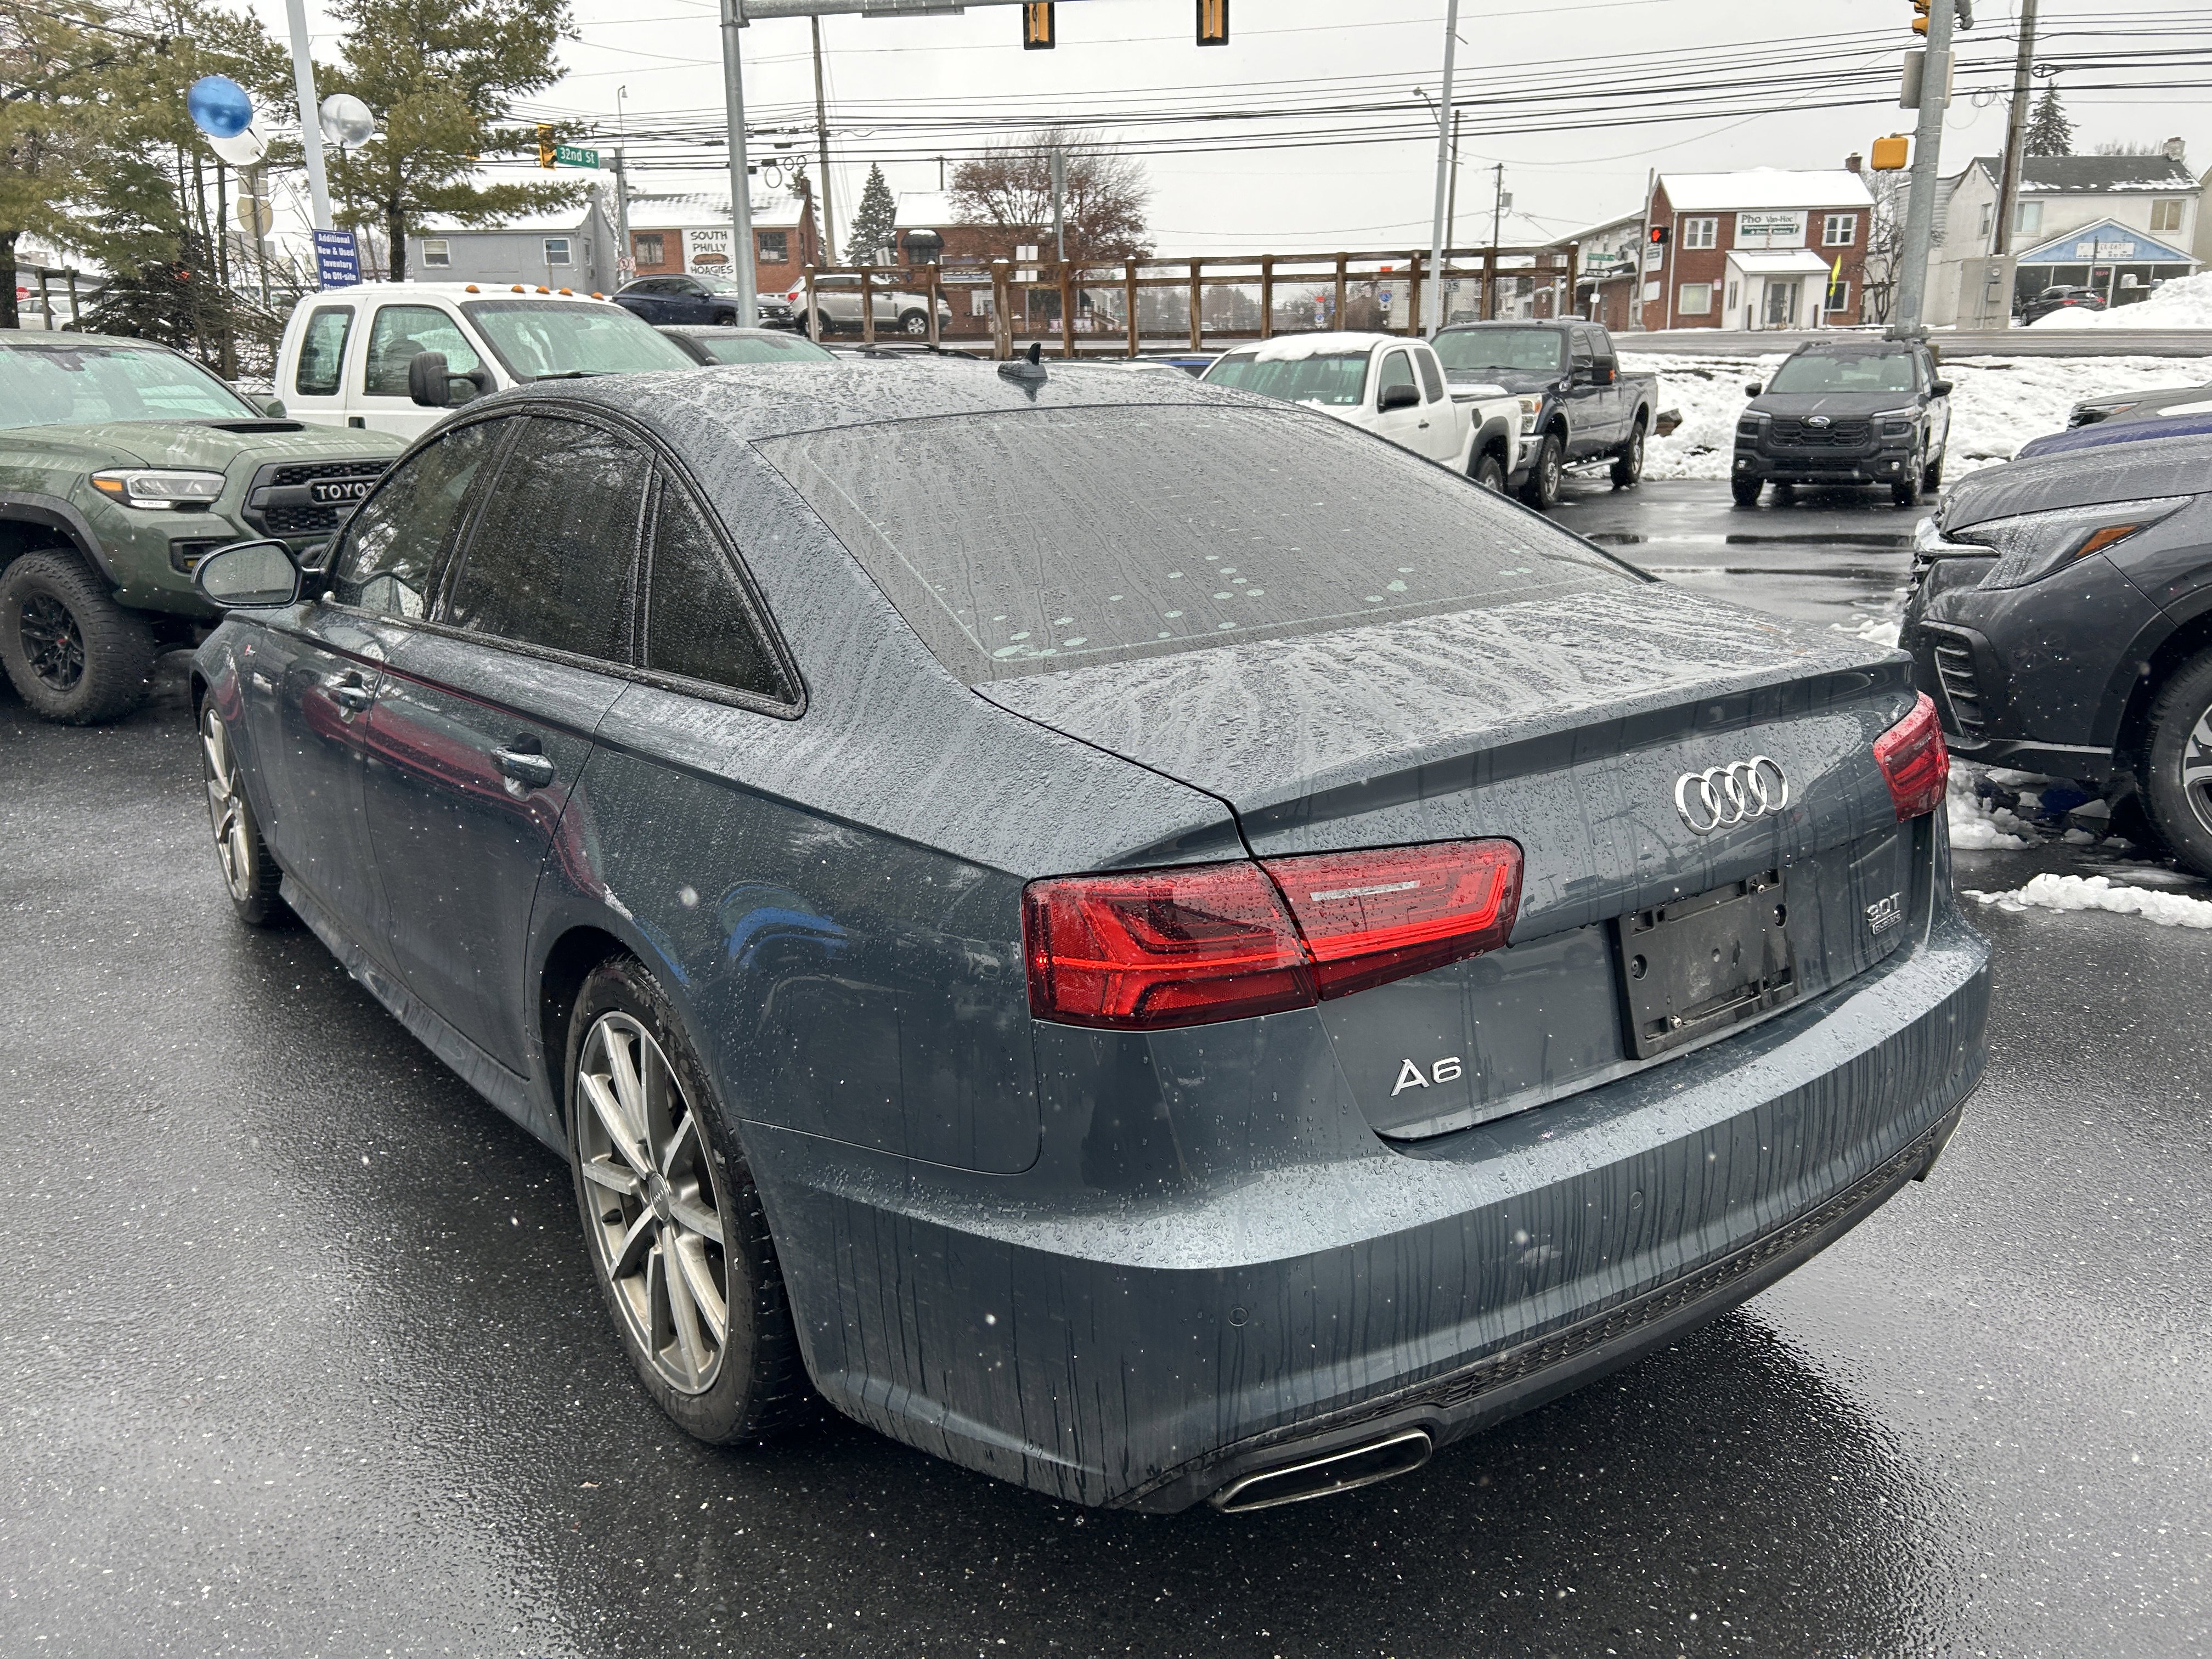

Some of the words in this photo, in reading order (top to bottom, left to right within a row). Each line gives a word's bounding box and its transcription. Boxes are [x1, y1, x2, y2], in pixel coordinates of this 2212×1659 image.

[560, 147, 583, 162] 32nd
[585, 151, 595, 164] St
[1741, 215, 1762, 223] Pho
[318, 233, 351, 244] Additional
[691, 230, 728, 241] SOUTH
[317, 245, 331, 255] New
[332, 246, 338, 255] &
[338, 247, 354, 256] Used
[693, 243, 727, 252] PHILLY
[323, 258, 352, 270] Inventory
[323, 270, 332, 279] On
[332, 271, 357, 281] Off-site
[690, 266, 734, 274] HOAGIES
[1390, 1056, 1462, 1097] A6
